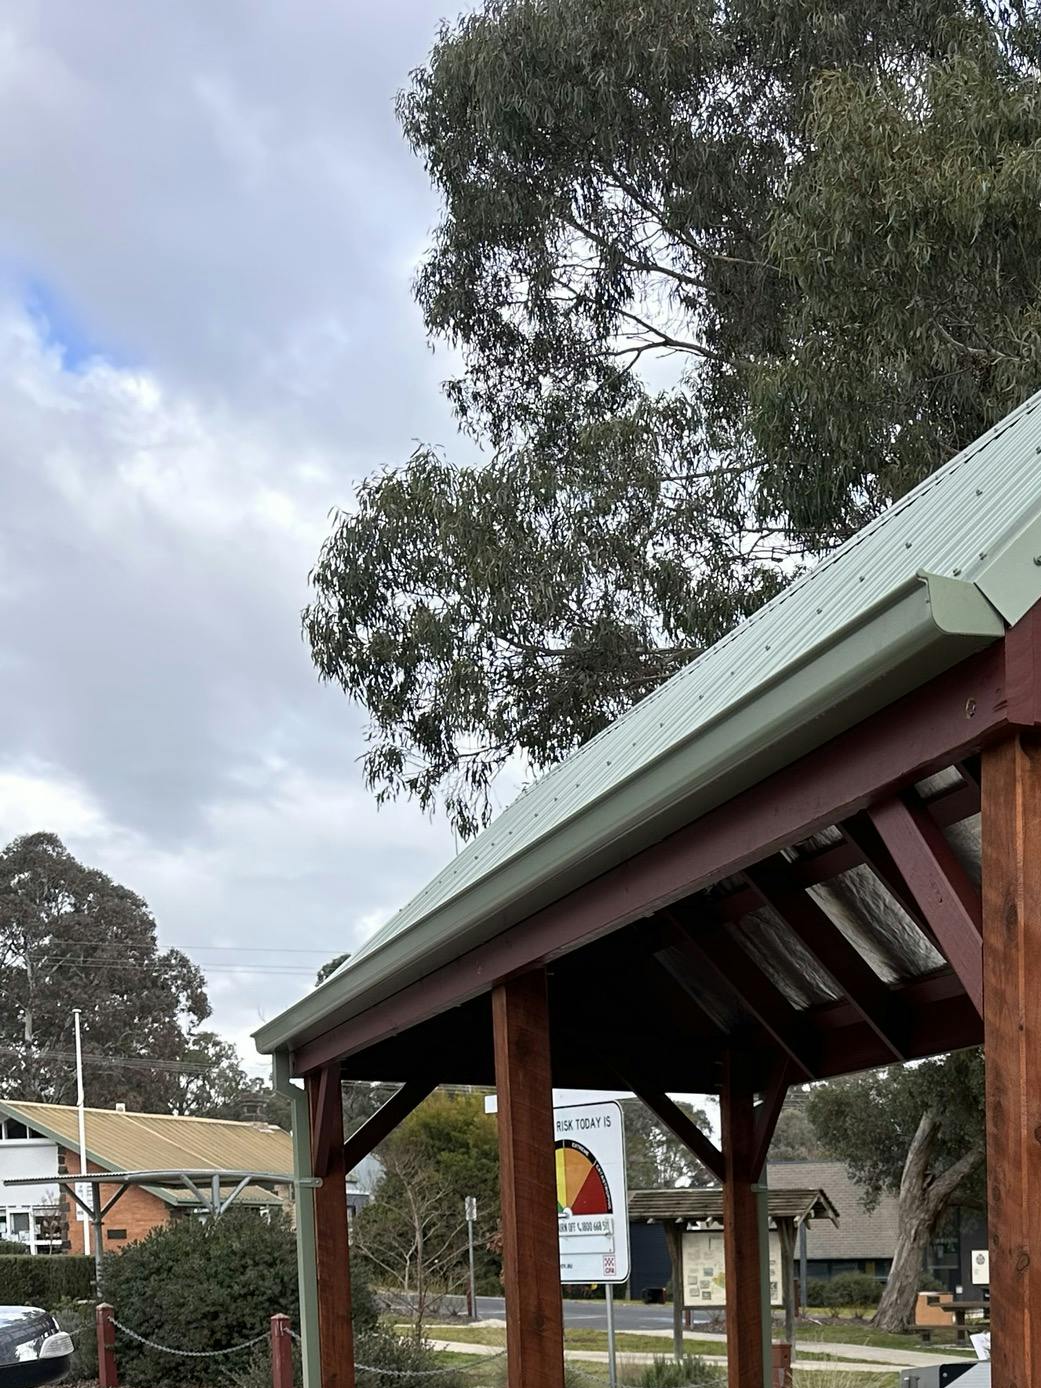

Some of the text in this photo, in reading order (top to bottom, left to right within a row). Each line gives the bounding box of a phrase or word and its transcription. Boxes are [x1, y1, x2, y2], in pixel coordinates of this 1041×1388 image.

[556, 1115, 611, 1132] RISK TODAY IS
